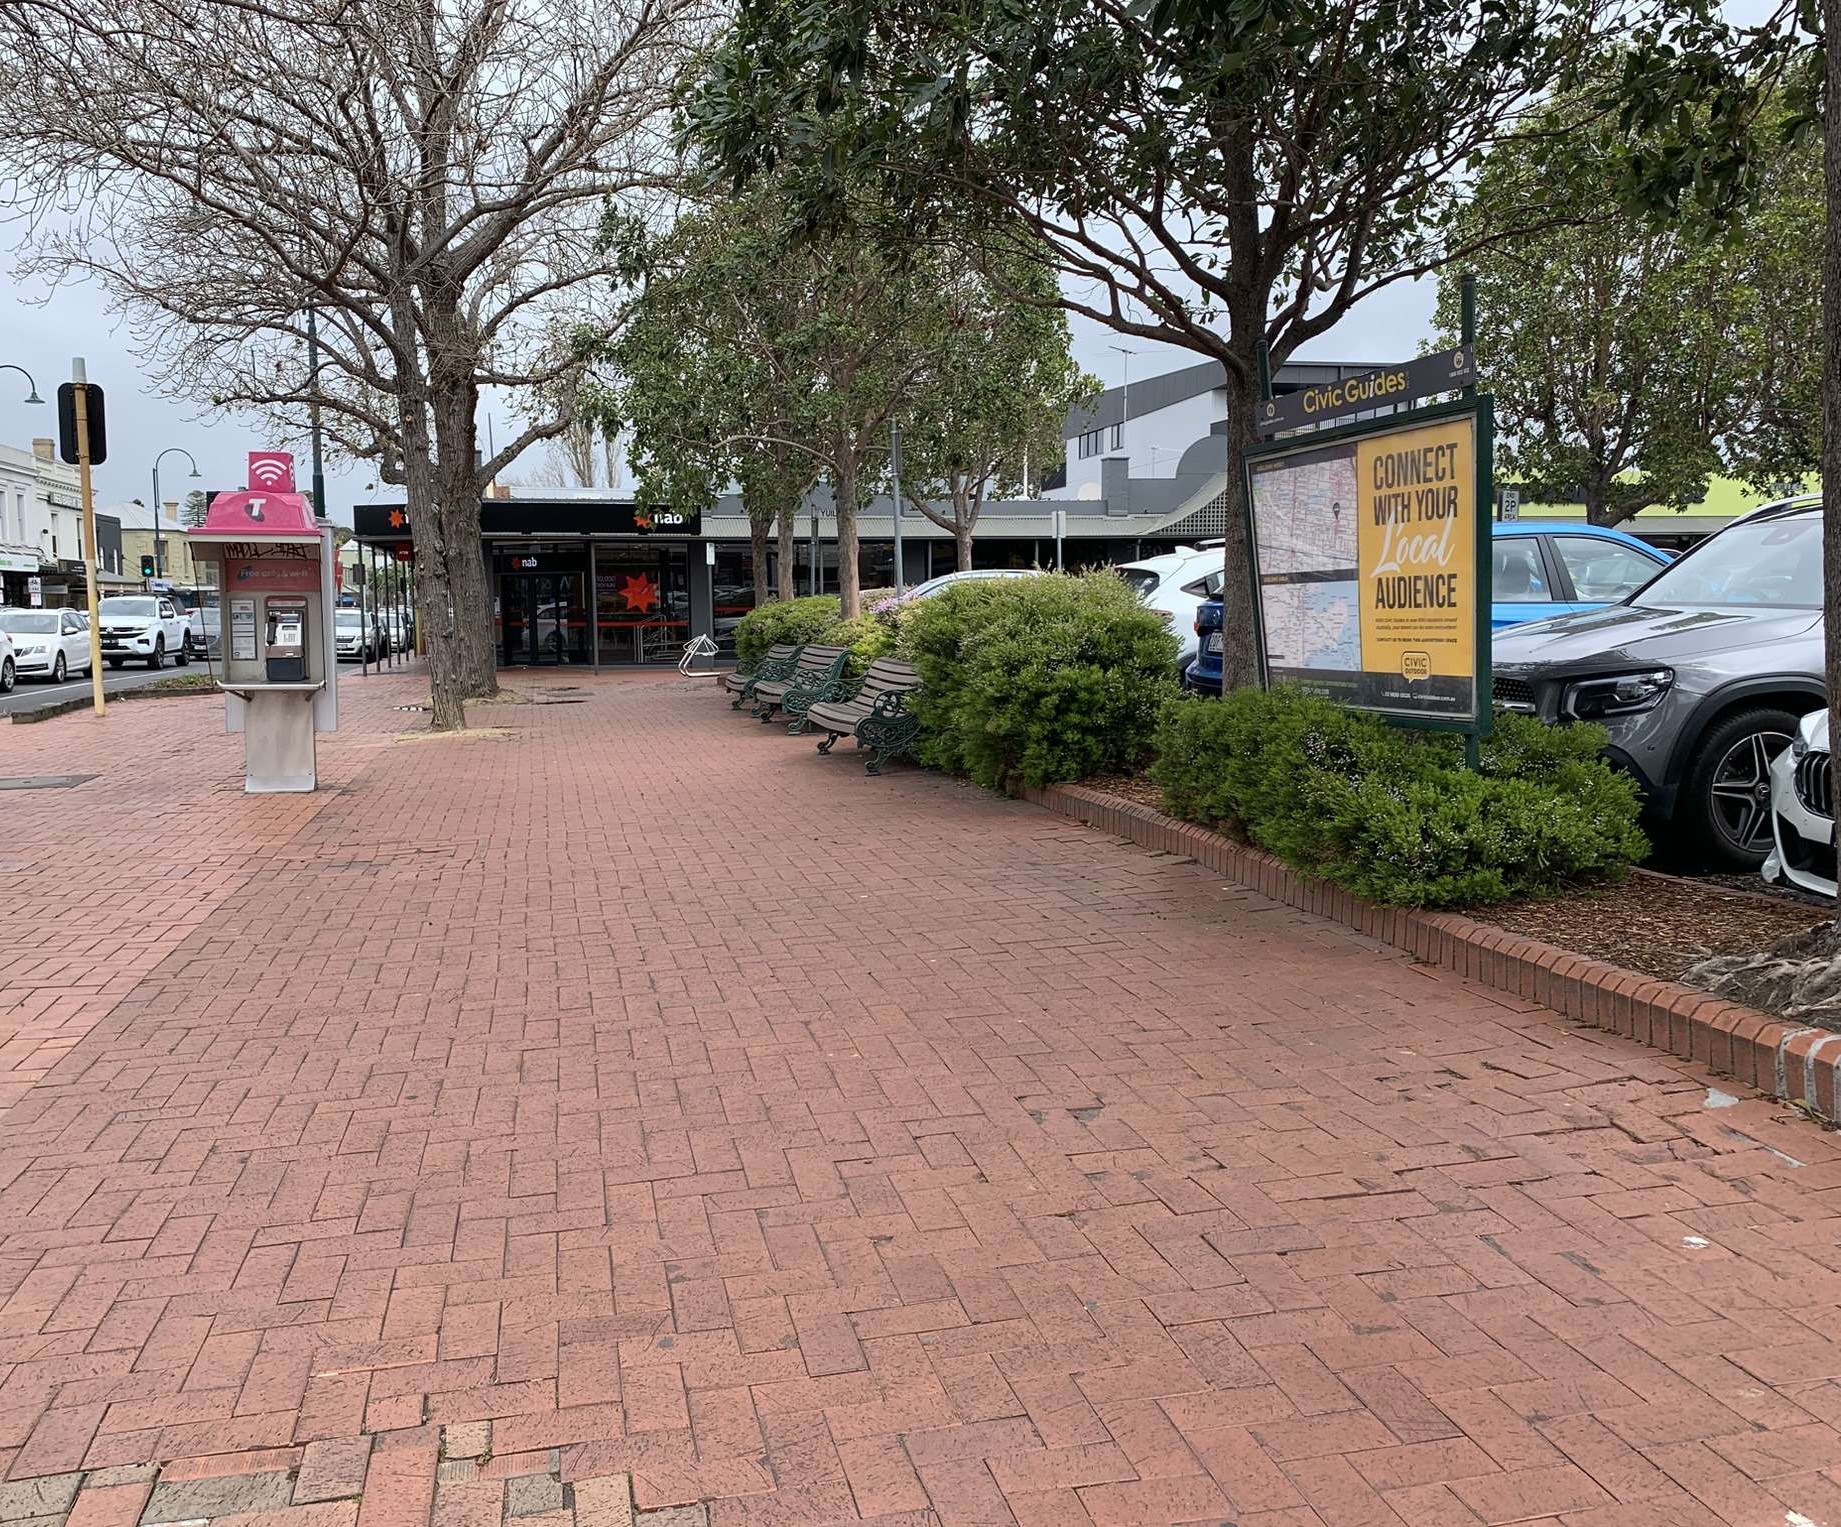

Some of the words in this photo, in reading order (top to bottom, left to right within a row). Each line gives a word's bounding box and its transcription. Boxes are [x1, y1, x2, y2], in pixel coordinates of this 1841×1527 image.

[1303, 386, 1343, 414] Civic
[1345, 372, 1406, 404] Guides
[1373, 442, 1458, 490] CONNECT
[249, 498, 267, 517] T
[654, 510, 683, 524] nab
[1373, 491, 1411, 526] WITH
[1415, 485, 1458, 522] YOUR
[1505, 500, 1516, 512] 2P
[1370, 505, 1456, 578] Local
[521, 556, 538, 567] nab
[1375, 573, 1458, 609] AUDIENCE
[1404, 657, 1427, 668] CIVIC
